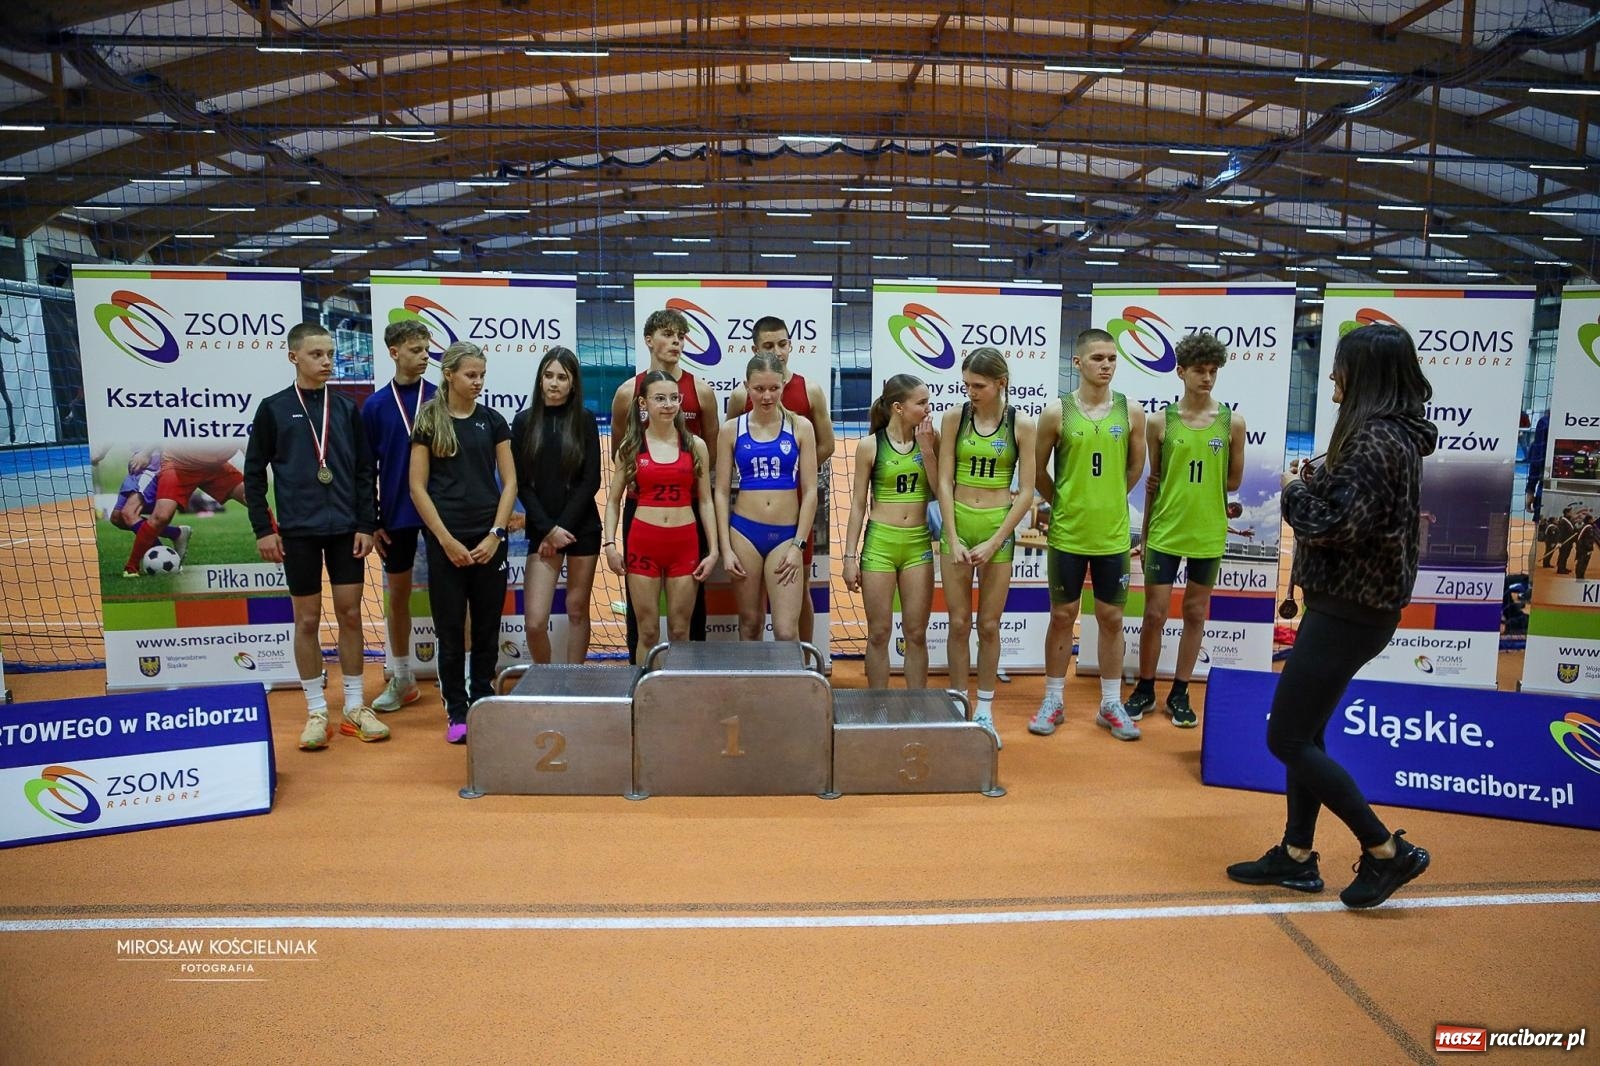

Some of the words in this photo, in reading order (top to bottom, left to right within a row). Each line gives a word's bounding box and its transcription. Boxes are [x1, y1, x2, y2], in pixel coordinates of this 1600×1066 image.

[184, 313, 285, 336] ZSOMS
[469, 317, 561, 340] ZSOMS
[727, 319, 817, 340] ZSMS
[961, 324, 1046, 346] ZSOMS
[186, 339, 286, 350] RACIBÓRZ
[482, 342, 561, 353] ACIBÓR
[727, 344, 817, 353] RARZ
[961, 347, 1046, 359] RBÓRZ
[1418, 330, 1514, 353] ZSOMS
[1230, 351, 1277, 361] BÓRZ
[106, 387, 251, 413] Kształcimy
[163, 418, 253, 438] Mistrz
[1565, 412, 1600, 427] bez
[750, 456, 781, 479] 153
[969, 456, 997, 479] 111
[1092, 453, 1102, 478] 9
[1189, 459, 1203, 484] 11
[653, 483, 681, 502] 25
[628, 553, 650, 571] 25
[207, 569, 249, 589] Piłka
[254, 568, 288, 588] noż
[1435, 576, 1493, 601] Zapasy
[136, 631, 290, 649] www.smsraciborz.pl
[120, 718, 138, 734] w
[145, 706, 258, 731] Raciborzu
[1344, 698, 1494, 748] Śląskie.
[720, 715, 745, 759] 1
[534, 731, 568, 773] 2
[901, 743, 931, 781] 3
[106, 768, 200, 797] ZSOMS
[1395, 769, 1574, 809] smsraciborz.pl
[107, 790, 200, 809] RACIBÓRZ
